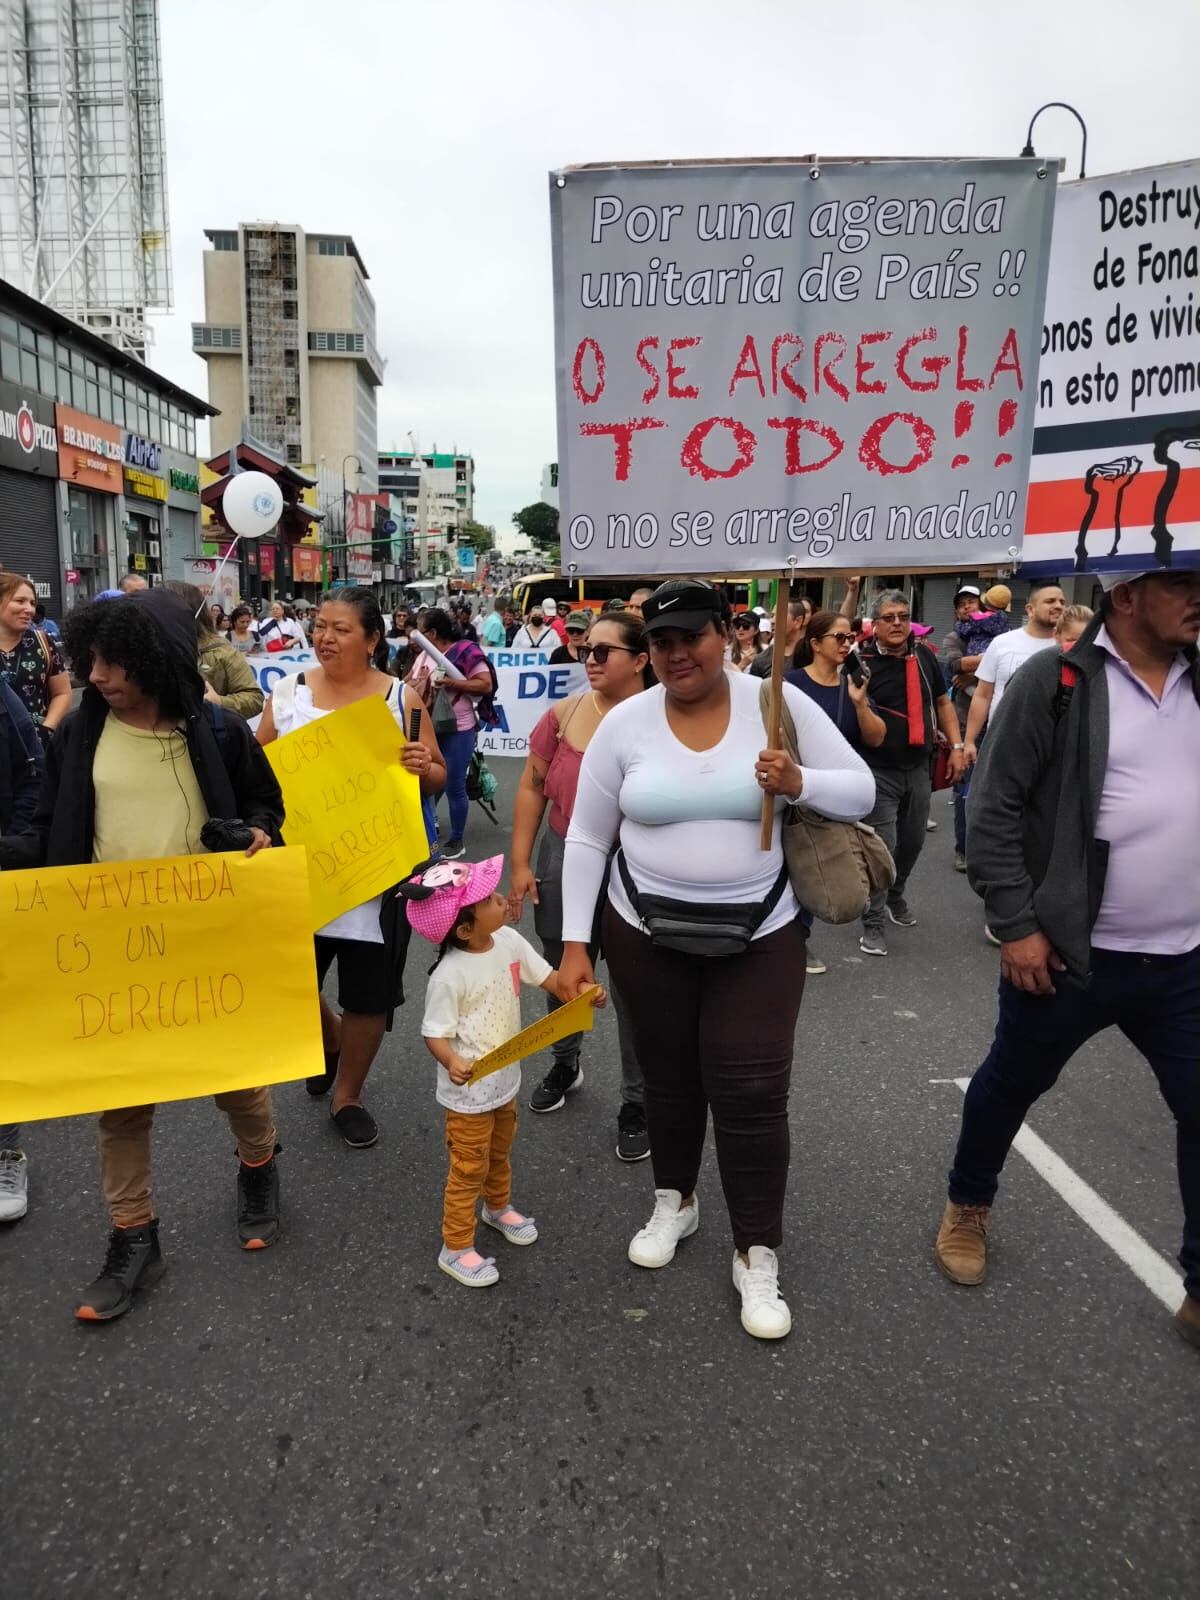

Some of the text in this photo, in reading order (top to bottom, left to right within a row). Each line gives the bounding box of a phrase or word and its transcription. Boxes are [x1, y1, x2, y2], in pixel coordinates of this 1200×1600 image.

[591, 182, 1005, 253] Por una agenda
[581, 255, 784, 308] unitaria
[800, 253, 862, 302] de
[876, 249, 981, 300] País
[1093, 246, 1125, 290] de
[1106, 303, 1138, 346] de
[572, 325, 1024, 405] O SE ARREGLA
[1066, 362, 1119, 406] esto
[1131, 361, 1200, 412] prom
[34, 422, 58, 453] PIZZA
[579, 399, 1018, 481] TODO!!
[569, 490, 1017, 558] o no se arregla nada!!
[518, 669, 571, 700] DE
[278, 725, 334, 775] CASA
[482, 737, 498, 750] AL
[321, 770, 377, 812] LUJO
[311, 799, 404, 881] DERECHO
[13, 859, 236, 912] LA VIVIENDA
[126, 922, 166, 962] UN
[72, 972, 244, 1040] DERECHO
